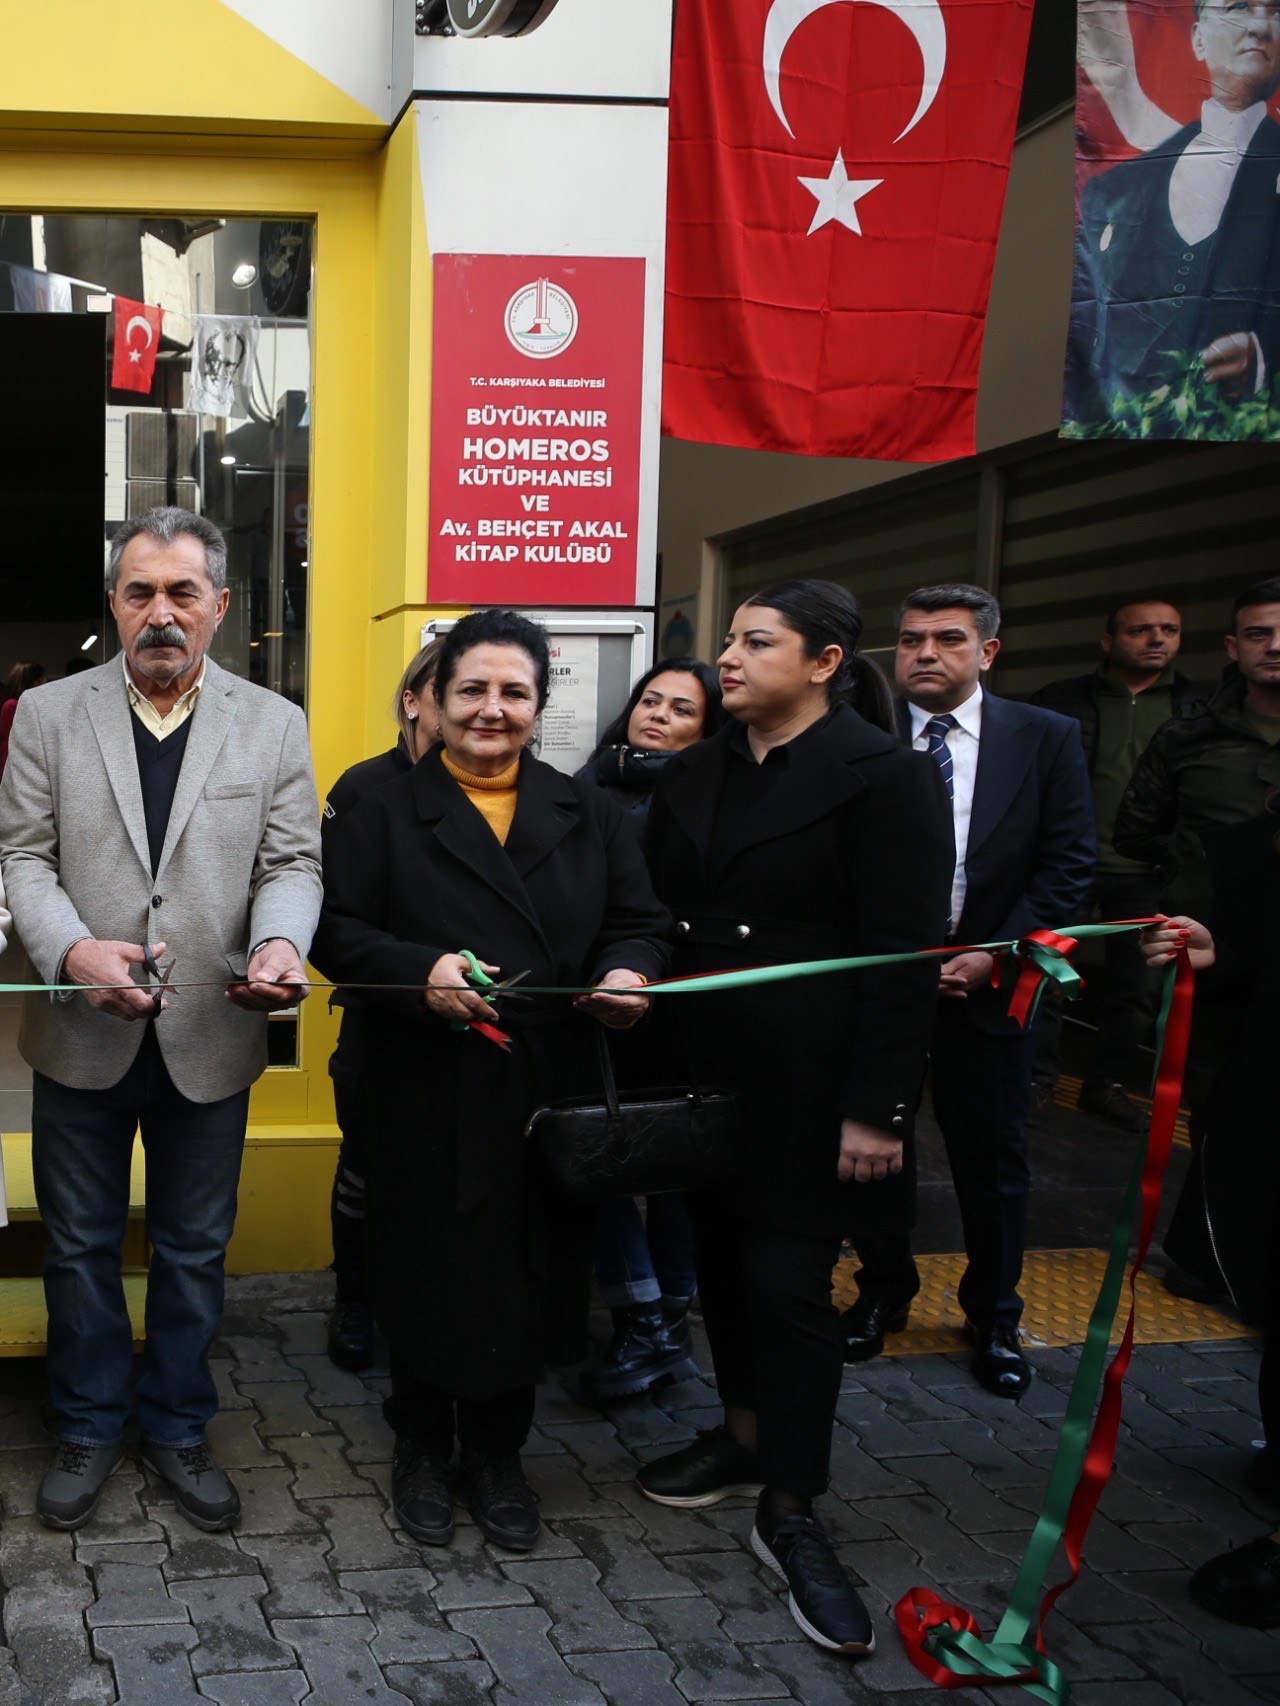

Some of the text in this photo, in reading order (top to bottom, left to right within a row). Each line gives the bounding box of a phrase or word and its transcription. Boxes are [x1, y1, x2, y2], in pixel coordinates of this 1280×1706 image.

[469, 377, 606, 389] T.C. KARŞIYAKA BELEDİYESİ
[466, 404, 608, 428] BÜYÜKTANIR
[463, 438, 610, 462] HOMEROS
[458, 465, 612, 488] KÜTÜPHANESİ
[520, 494, 550, 512] VE
[439, 519, 628, 541] Av. BEHÇET AKAL
[455, 540, 612, 564] KİTAP KULÜBÜ
[549, 667, 572, 676] RLER
